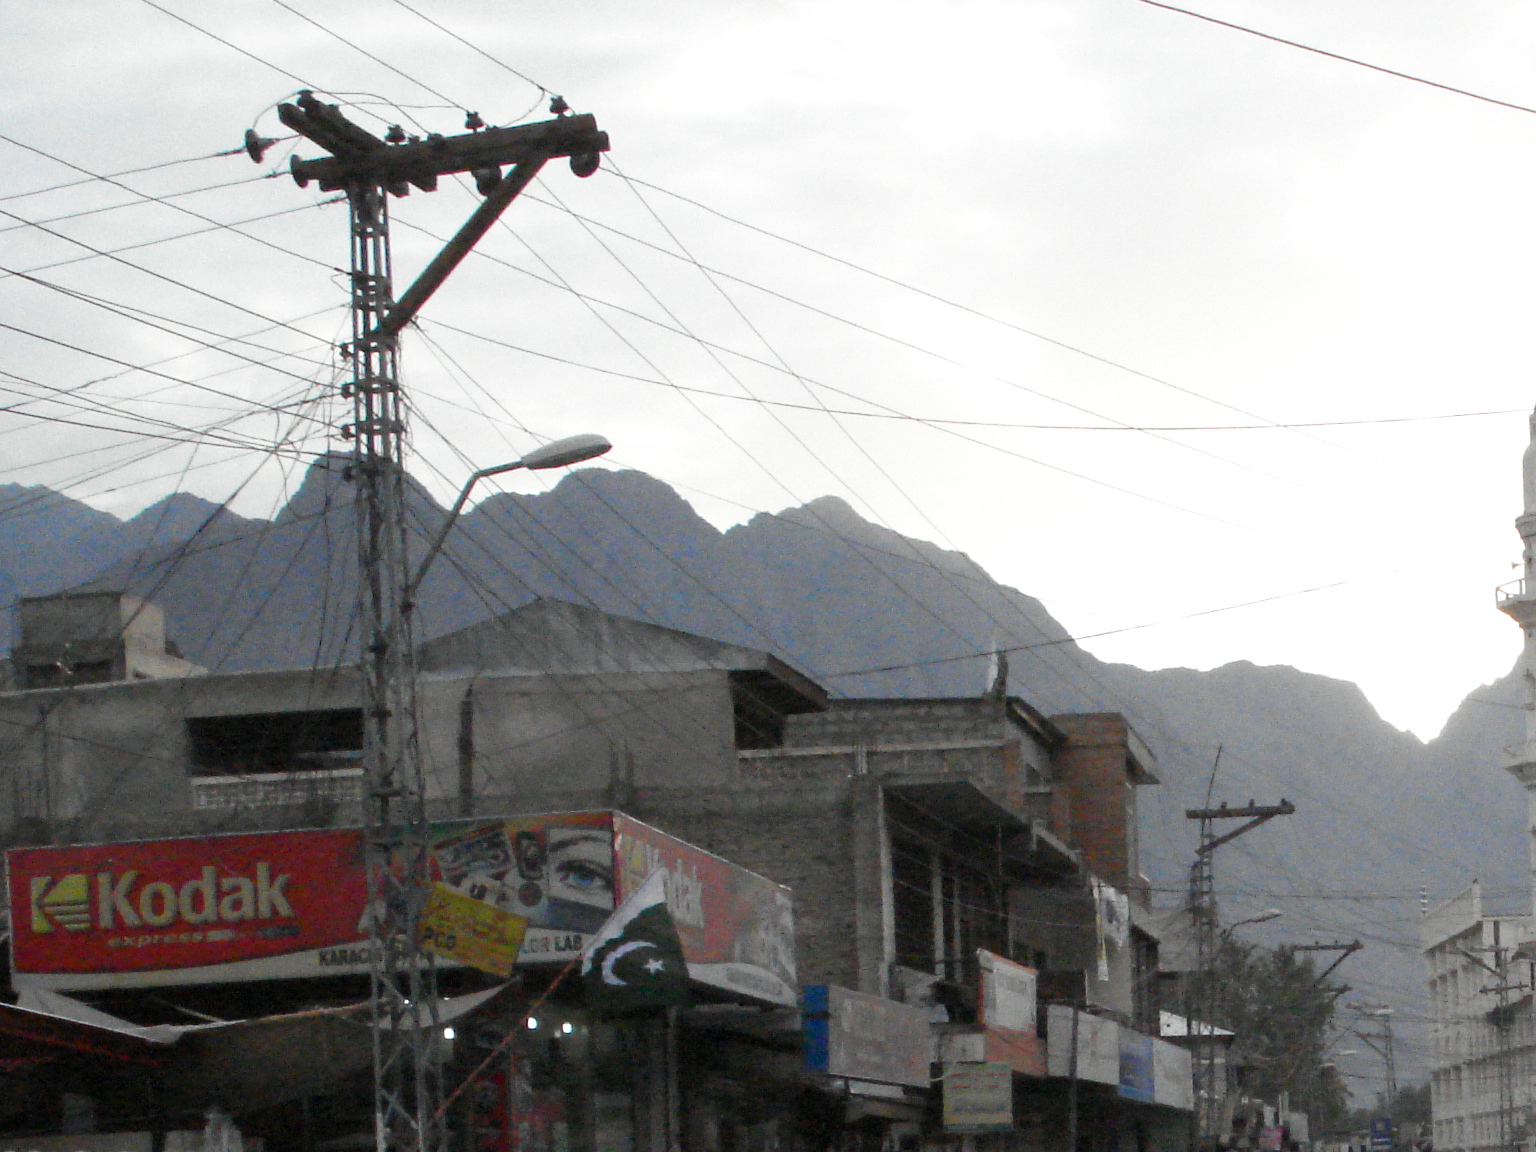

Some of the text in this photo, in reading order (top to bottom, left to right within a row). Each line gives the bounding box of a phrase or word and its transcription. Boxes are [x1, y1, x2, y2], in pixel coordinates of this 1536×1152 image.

[97, 862, 295, 929] Kodak
[107, 931, 203, 948] express
[554, 933, 583, 952] LAB
